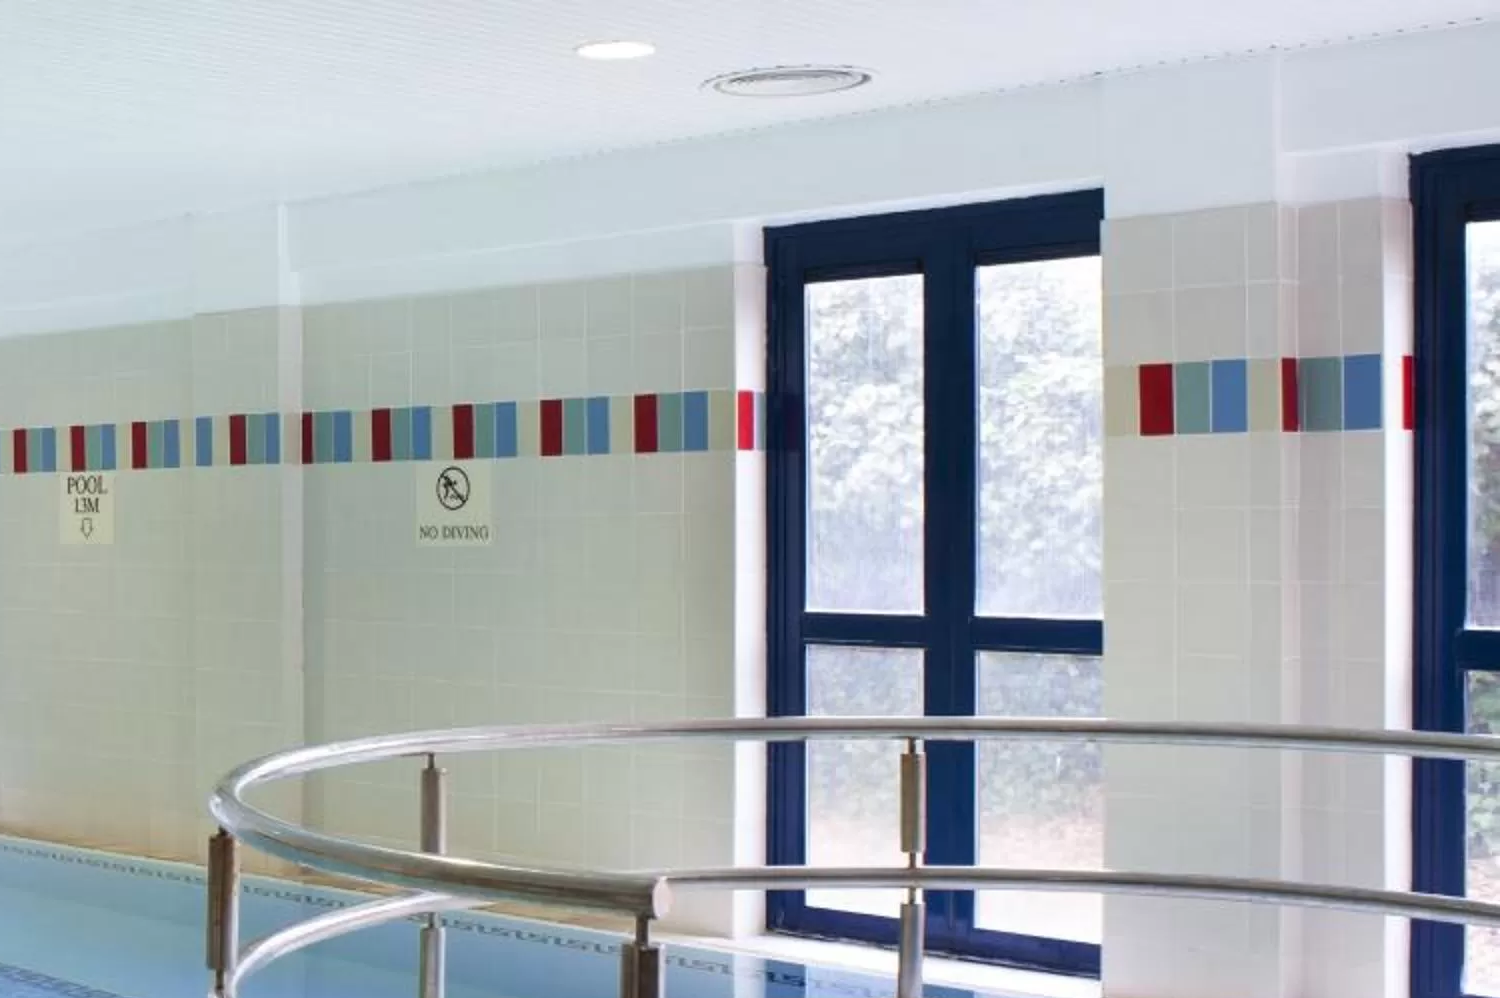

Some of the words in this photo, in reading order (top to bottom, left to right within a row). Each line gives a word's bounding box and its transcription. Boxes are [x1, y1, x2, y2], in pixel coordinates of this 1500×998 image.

[67, 475, 108, 494] POOL
[419, 525, 439, 540] NO
[442, 525, 489, 540] DIVING
